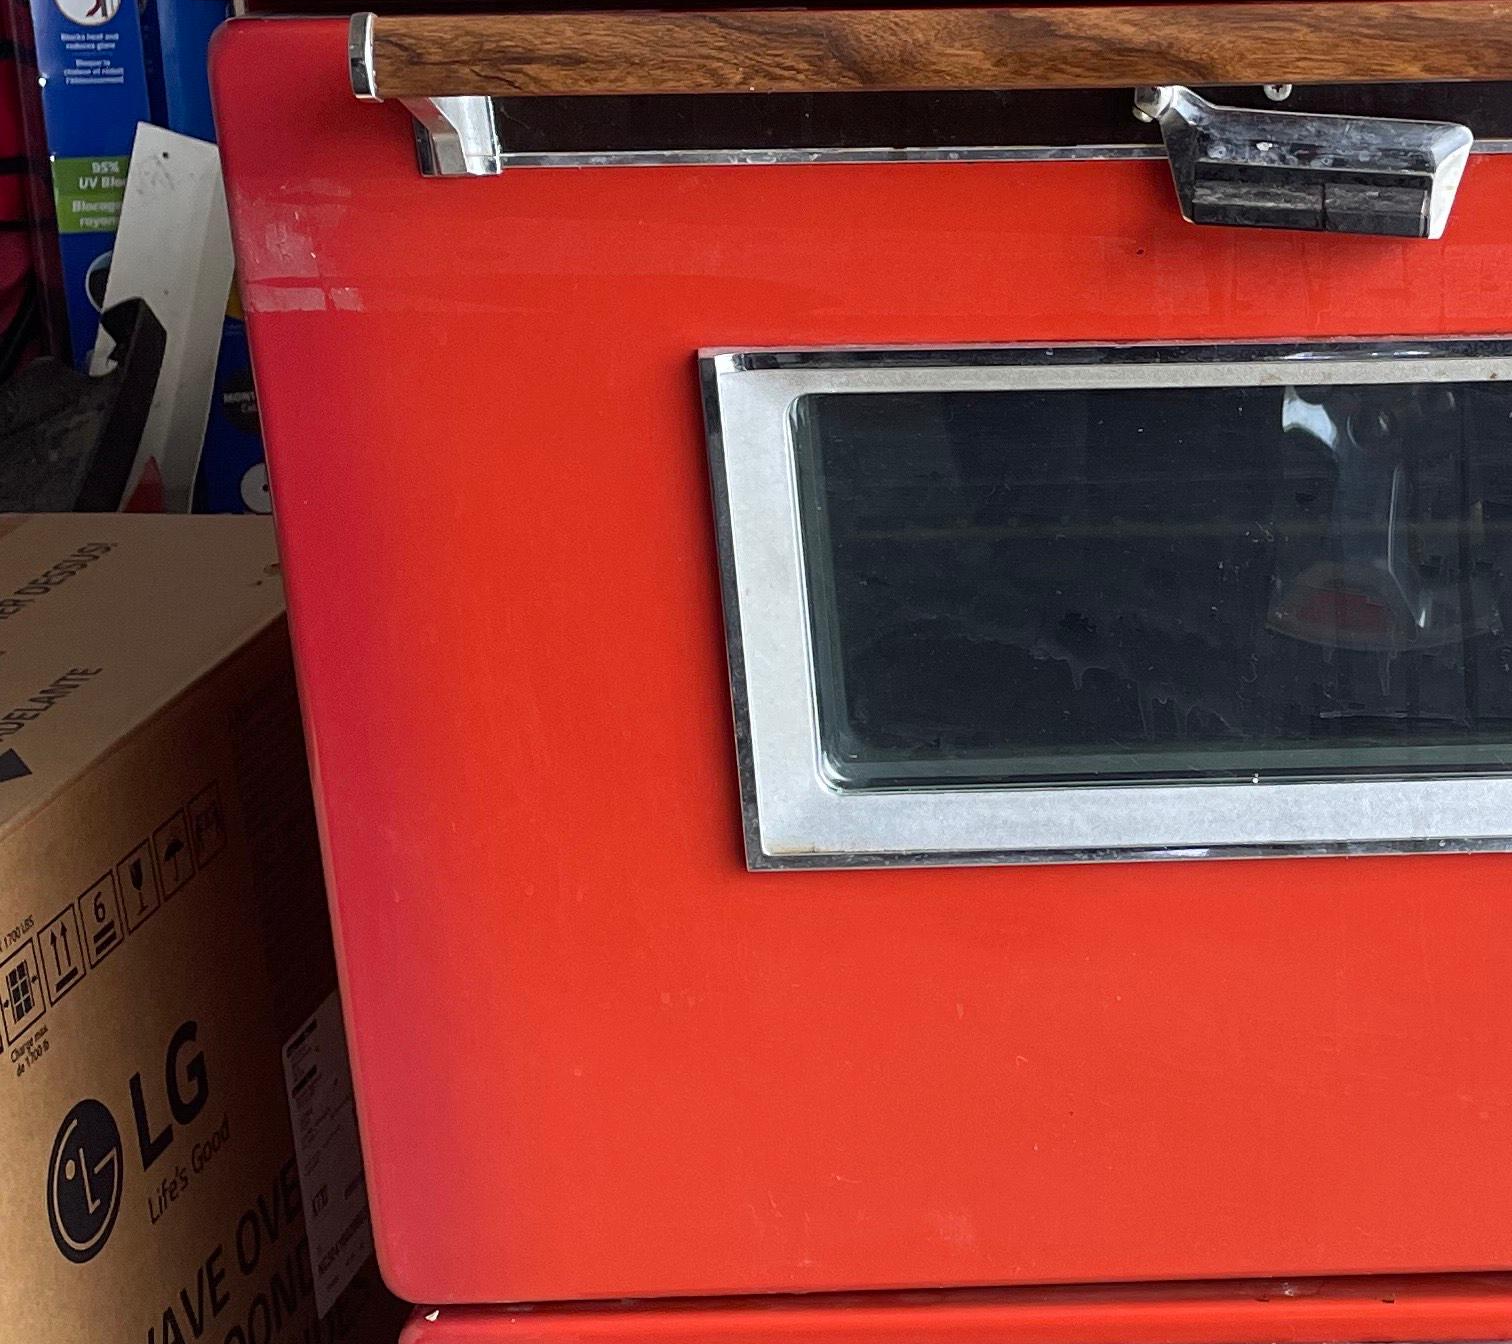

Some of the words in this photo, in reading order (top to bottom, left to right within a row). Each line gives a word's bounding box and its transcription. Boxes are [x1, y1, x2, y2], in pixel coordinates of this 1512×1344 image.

[79, 176, 98, 189] UV
[94, 892, 106, 923] 6
[128, 1020, 209, 1172] LG
[148, 1166, 189, 1226] Life's
[191, 1118, 230, 1175] Good
[235, 1149, 306, 1277] OVE
